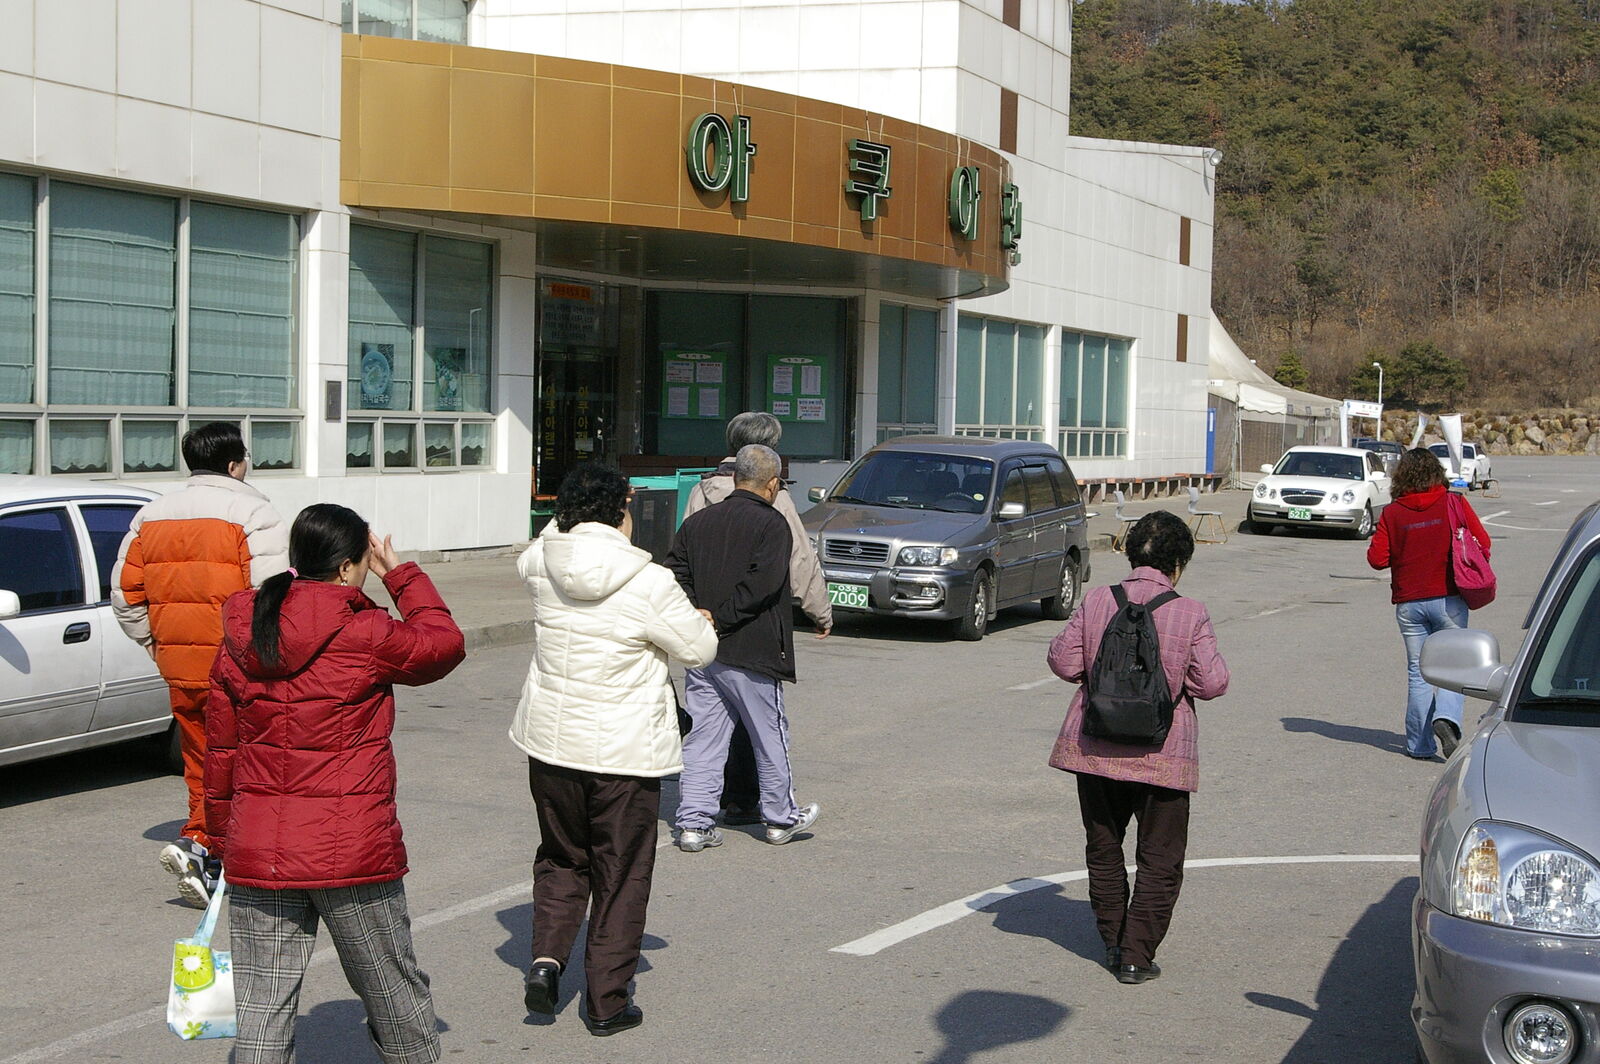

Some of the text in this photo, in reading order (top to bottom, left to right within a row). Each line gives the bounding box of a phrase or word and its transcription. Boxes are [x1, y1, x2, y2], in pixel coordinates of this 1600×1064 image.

[687, 112, 757, 202] 아
[846, 138, 893, 221] 쿠
[949, 165, 981, 241] 아
[829, 590, 867, 607] 7009
